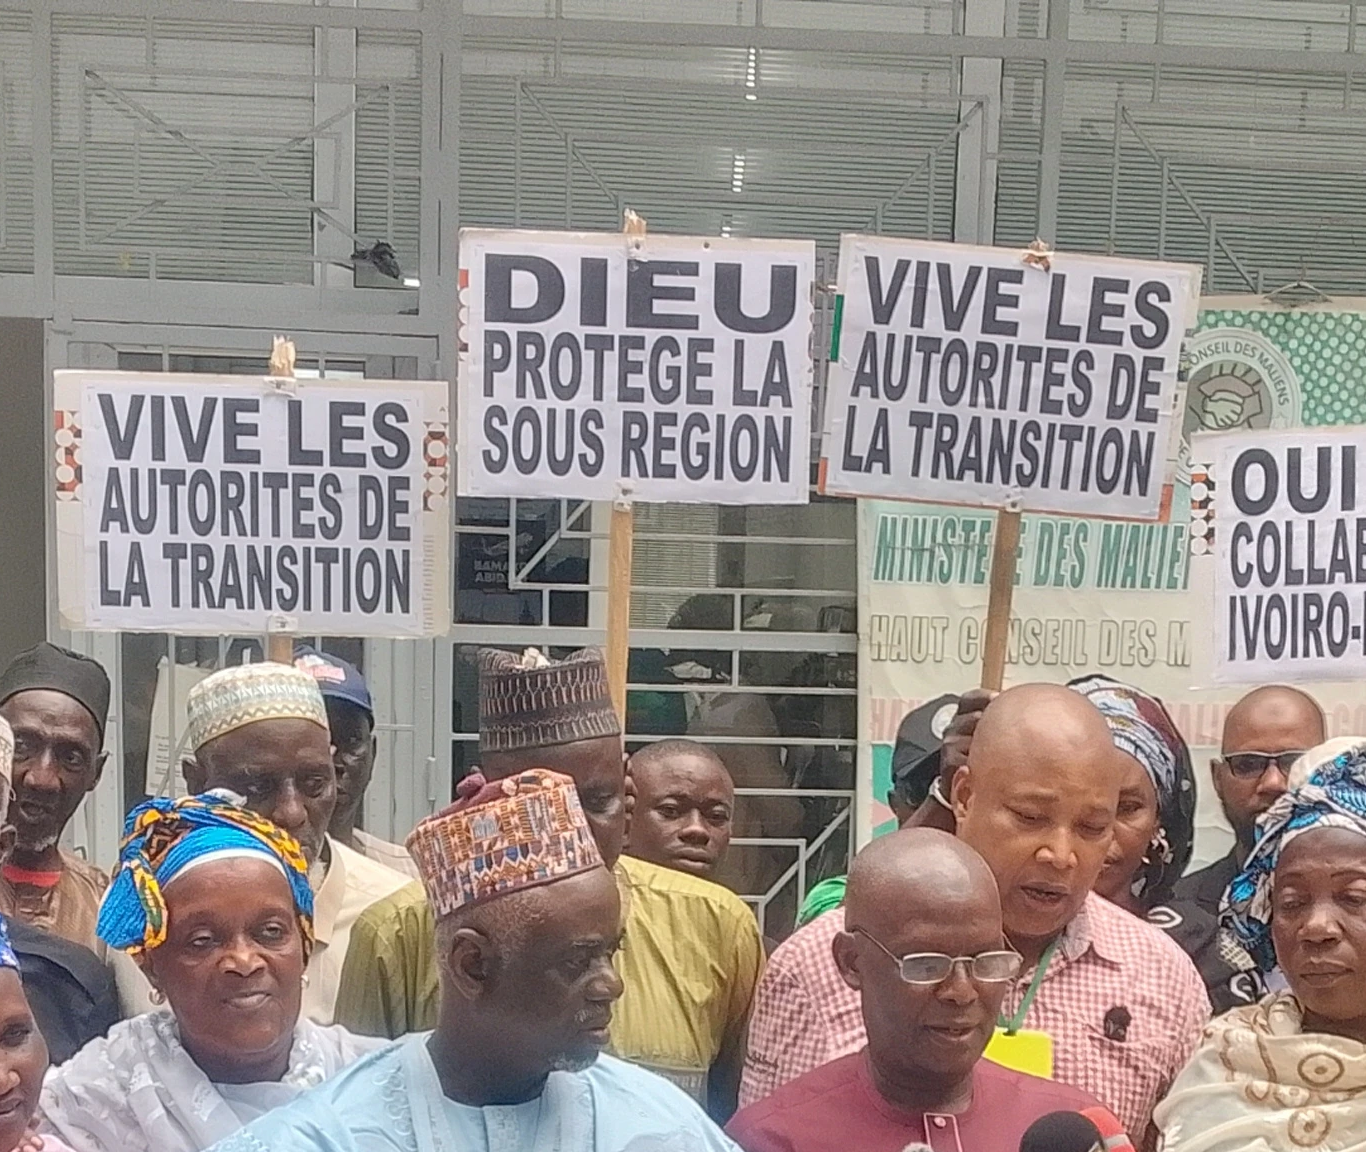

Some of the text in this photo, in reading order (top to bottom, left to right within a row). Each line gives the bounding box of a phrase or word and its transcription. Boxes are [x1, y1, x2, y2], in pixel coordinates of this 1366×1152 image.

[485, 254, 797, 334] DIEU
[865, 256, 1171, 349] VIVE LES
[484, 330, 792, 408] PROTEGE LA
[851, 331, 1165, 423] AUTORITES DE
[1189, 341, 1291, 407] ONSEIL DES MALIENS
[98, 394, 410, 470] VIVE LES
[482, 405, 791, 482] SOUS REGION
[842, 405, 1155, 497] LA TRANSITION
[100, 467, 410, 541] AUTORITES DE
[1231, 446, 1356, 516] OUI
[100, 541, 410, 614] LA TRANSITION
[873, 514, 1026, 587] MINISTEE
[1034, 519, 1089, 588] DES
[870, 615, 949, 662] HAUT
[959, 616, 1088, 666] CNSEIL
[1097, 619, 1157, 667] DES
